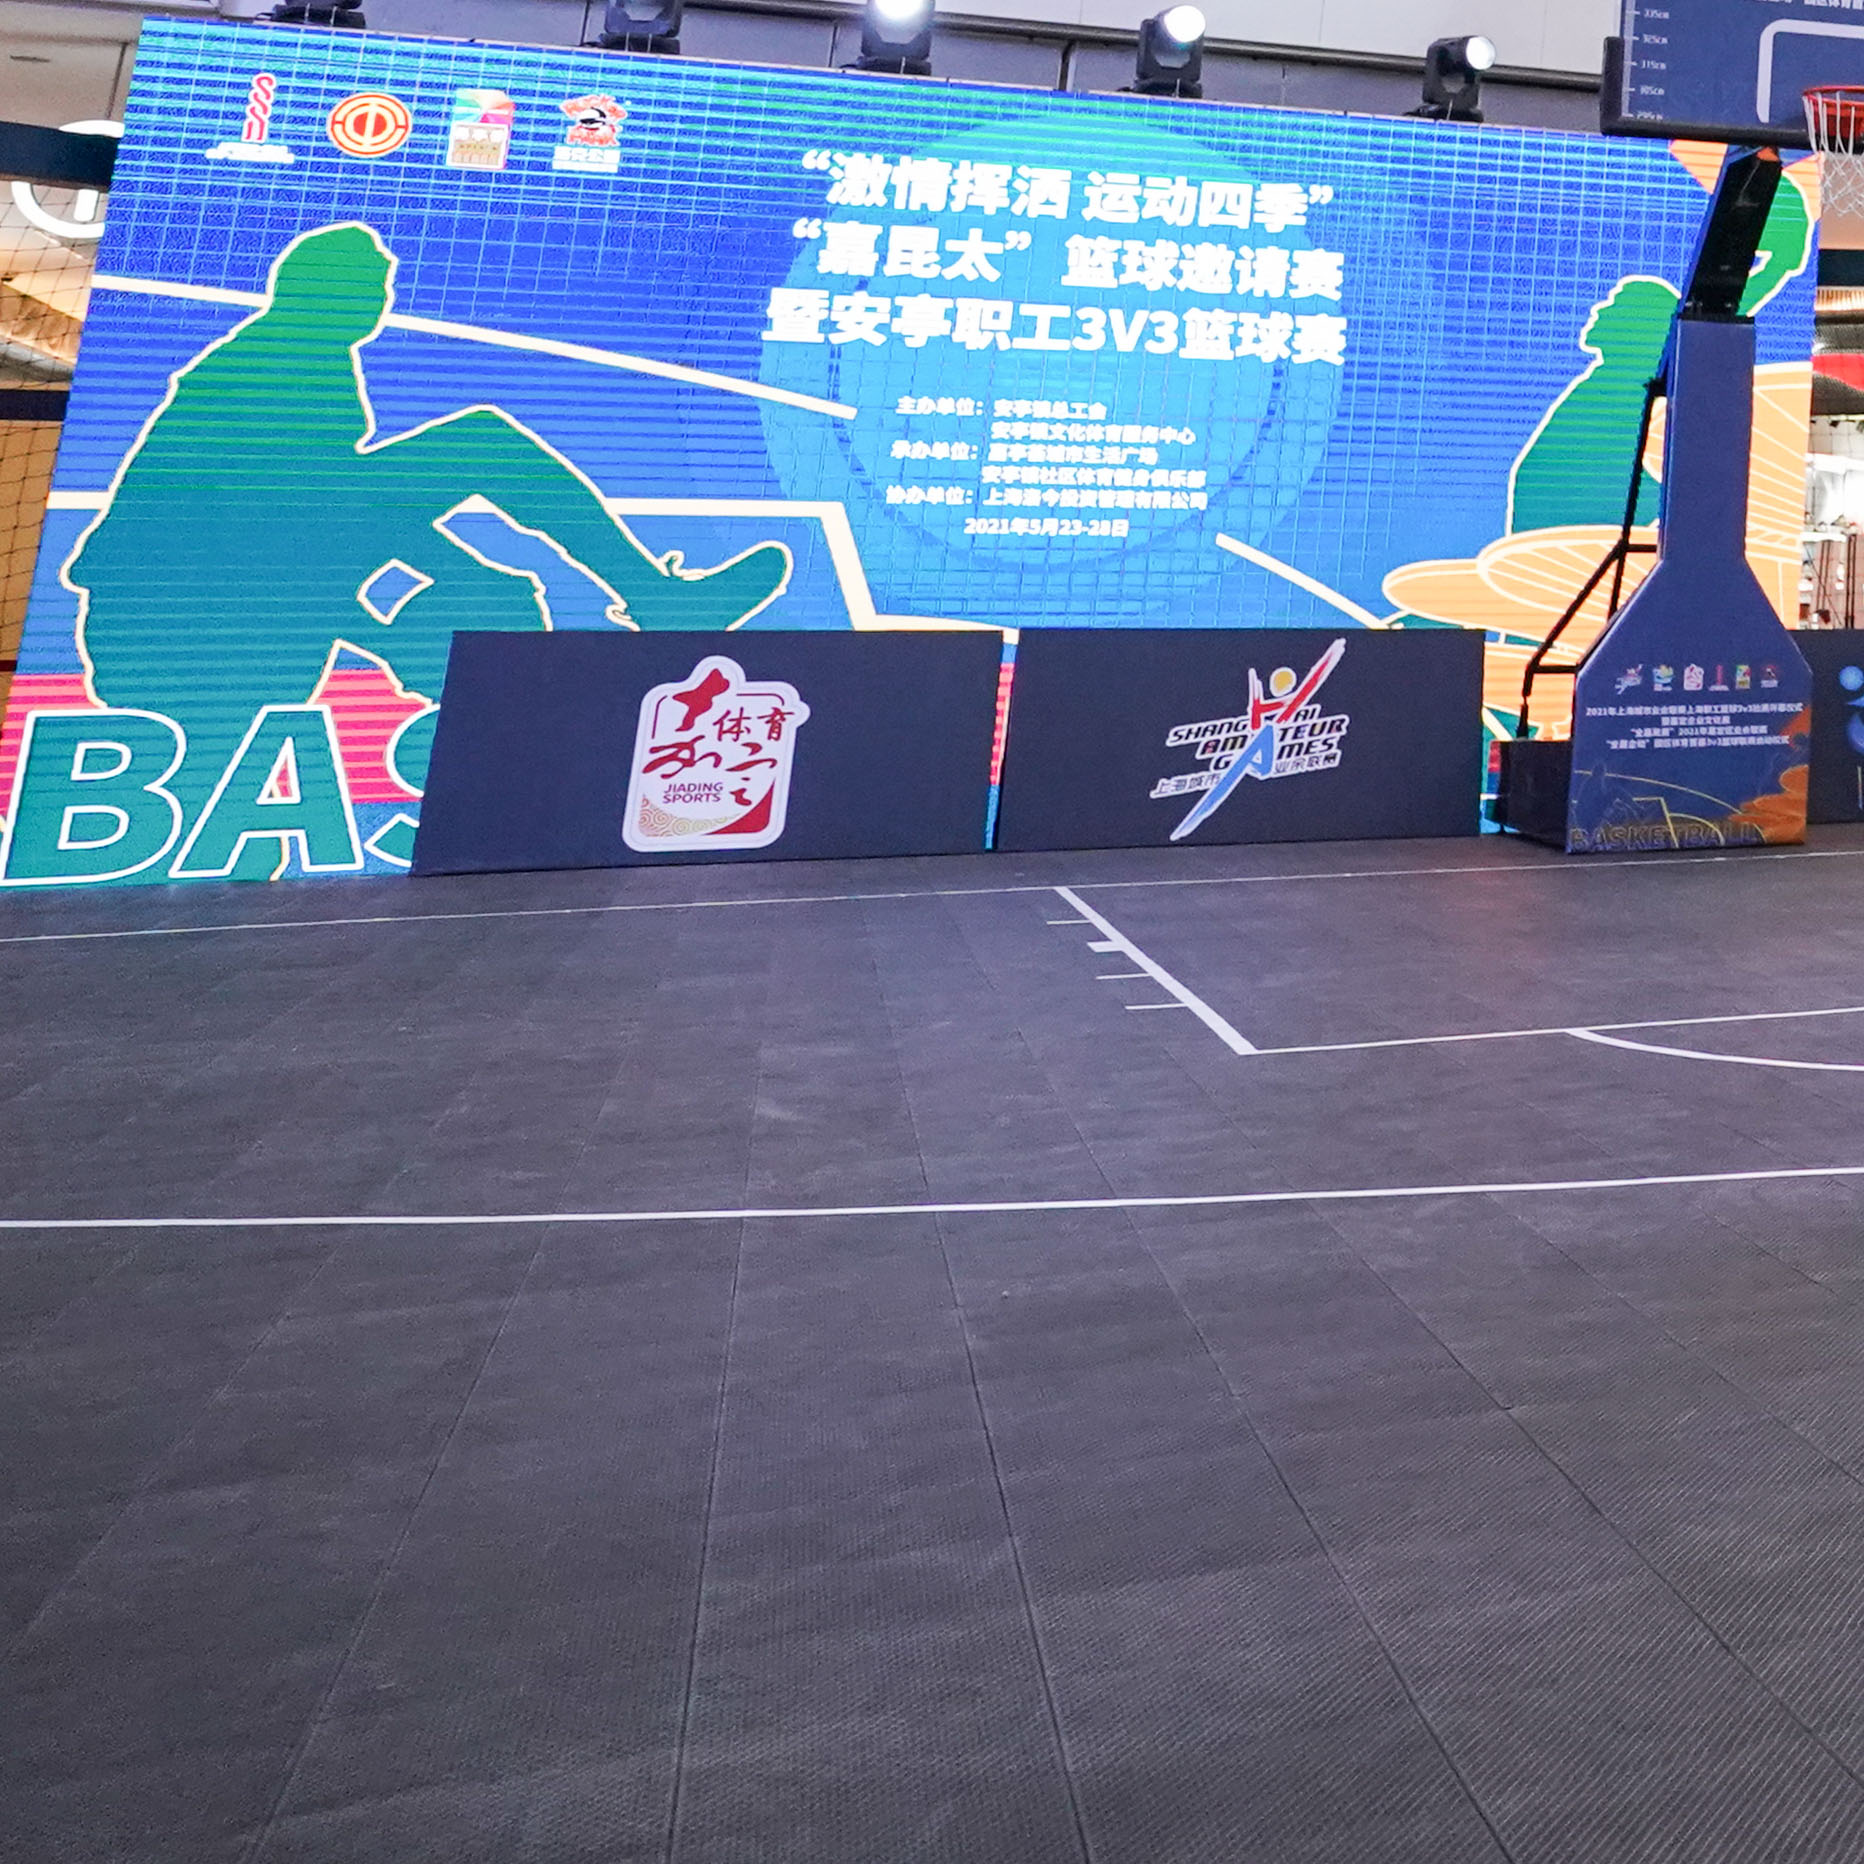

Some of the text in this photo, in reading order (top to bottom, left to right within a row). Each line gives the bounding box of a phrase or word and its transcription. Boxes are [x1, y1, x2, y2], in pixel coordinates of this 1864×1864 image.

[800, 148, 1336, 234] “激情挥洒 运动四季”
[792, 216, 1347, 303] “嘉昆太” 篮球邀请赛
[761, 286, 1348, 368] 暨安亭职工3V3篮球赛
[712, 707, 796, 742] 体育
[662, 792, 721, 805] SPORTS
[664, 782, 724, 794] JIADING
